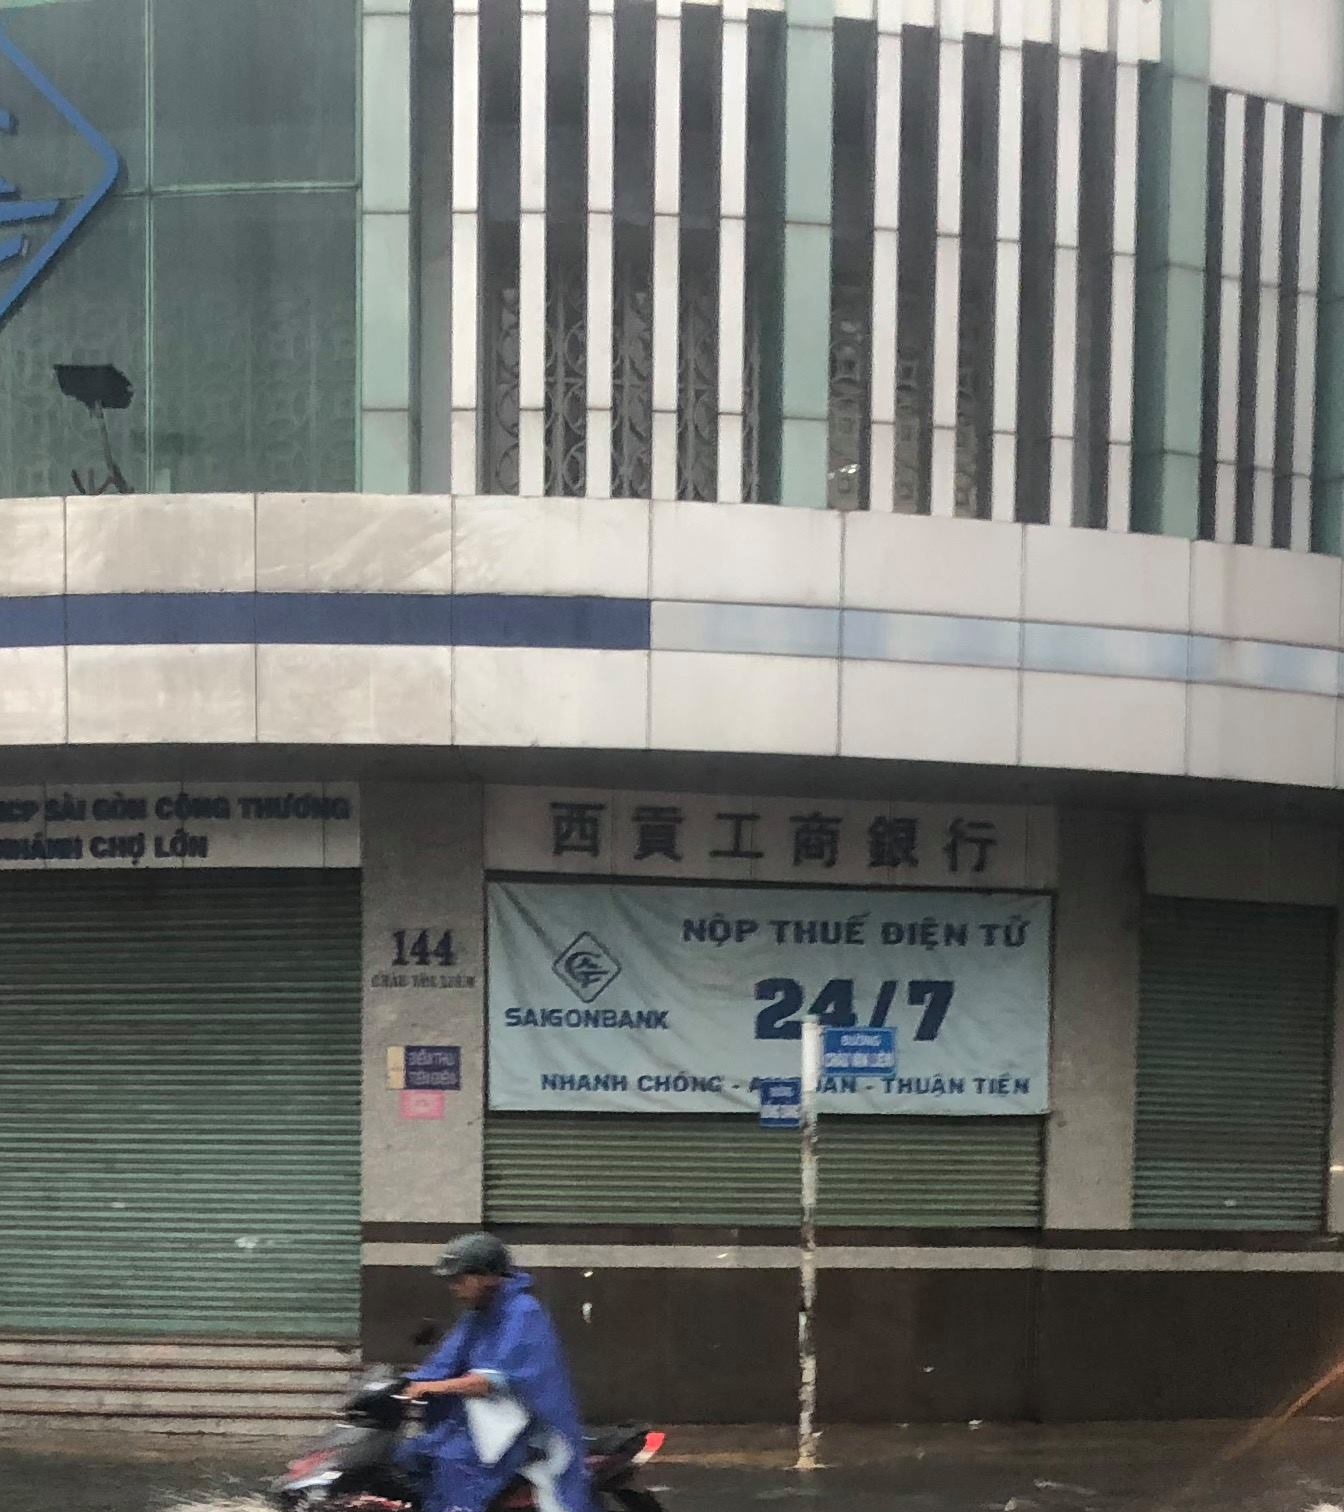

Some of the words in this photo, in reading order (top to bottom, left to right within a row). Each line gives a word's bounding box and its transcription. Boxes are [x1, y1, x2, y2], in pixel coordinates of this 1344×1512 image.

[550, 802, 997, 874] 西貢工商銀行
[392, 928, 457, 966] 144
[682, 913, 759, 947] NỘP
[770, 911, 871, 945] THUẾ
[881, 916, 968, 950] ĐIỆN
[505, 1007, 669, 1029] SAIGONBANK
[754, 977, 955, 1042] 24/7
[541, 1073, 627, 1092] NHANH
[880, 1073, 965, 1097] THUẬN
